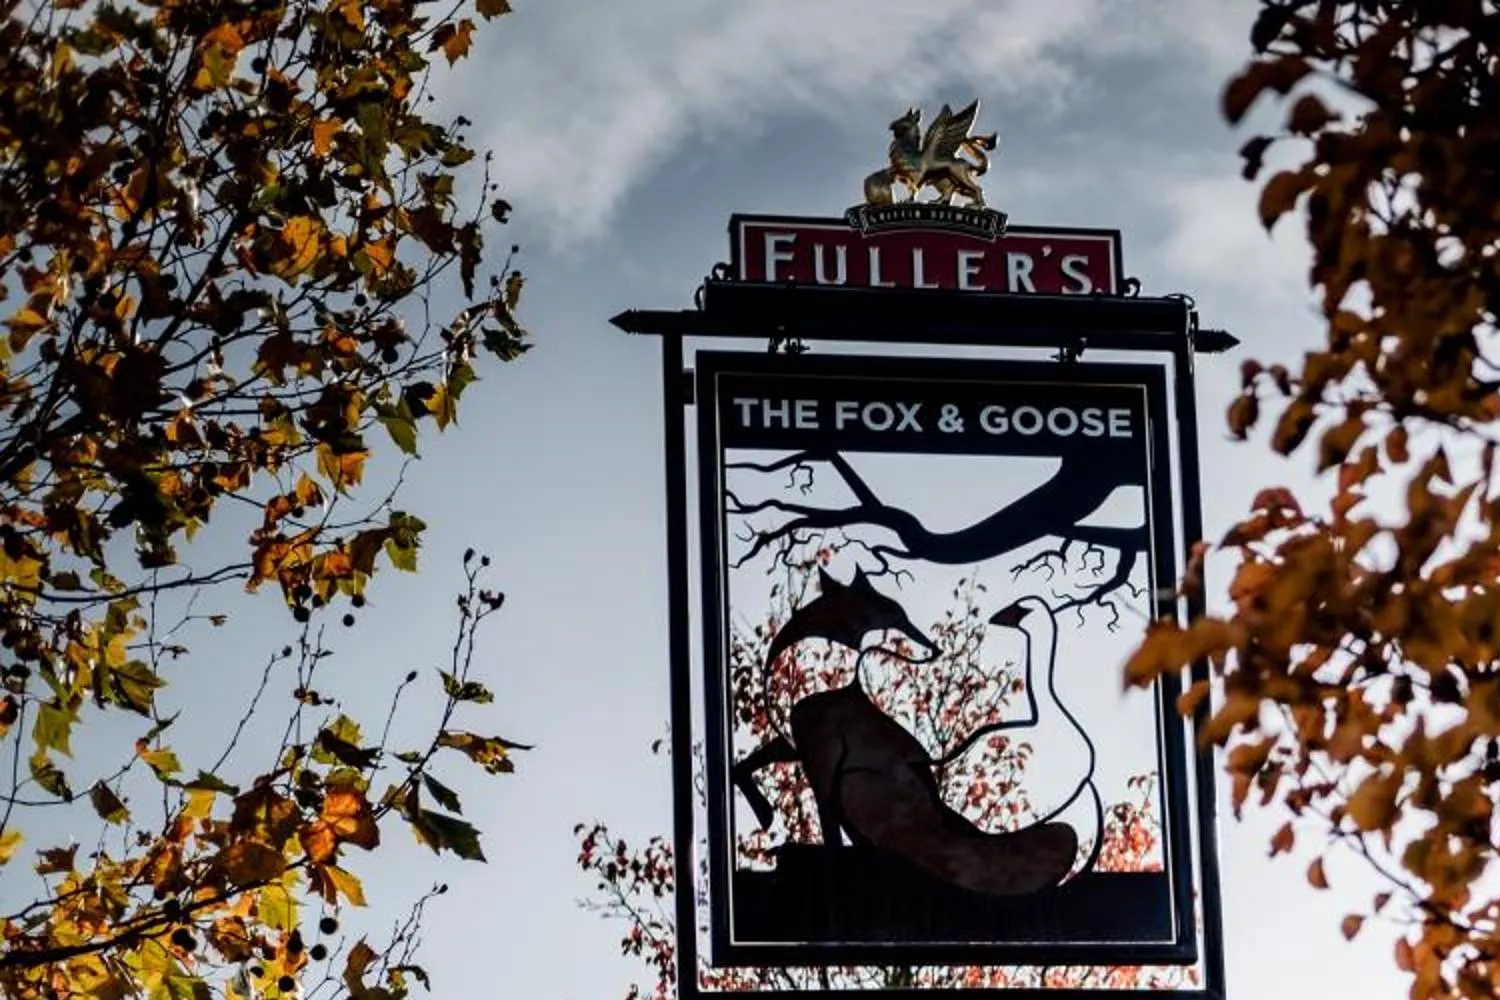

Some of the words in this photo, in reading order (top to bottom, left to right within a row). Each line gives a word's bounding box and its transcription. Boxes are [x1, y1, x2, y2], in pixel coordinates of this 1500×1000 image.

[764, 231, 1094, 296] FULLER'S
[733, 397, 820, 429] THE
[834, 401, 923, 433] FOX
[937, 403, 965, 433] &
[979, 405, 1133, 438] GOOSE
